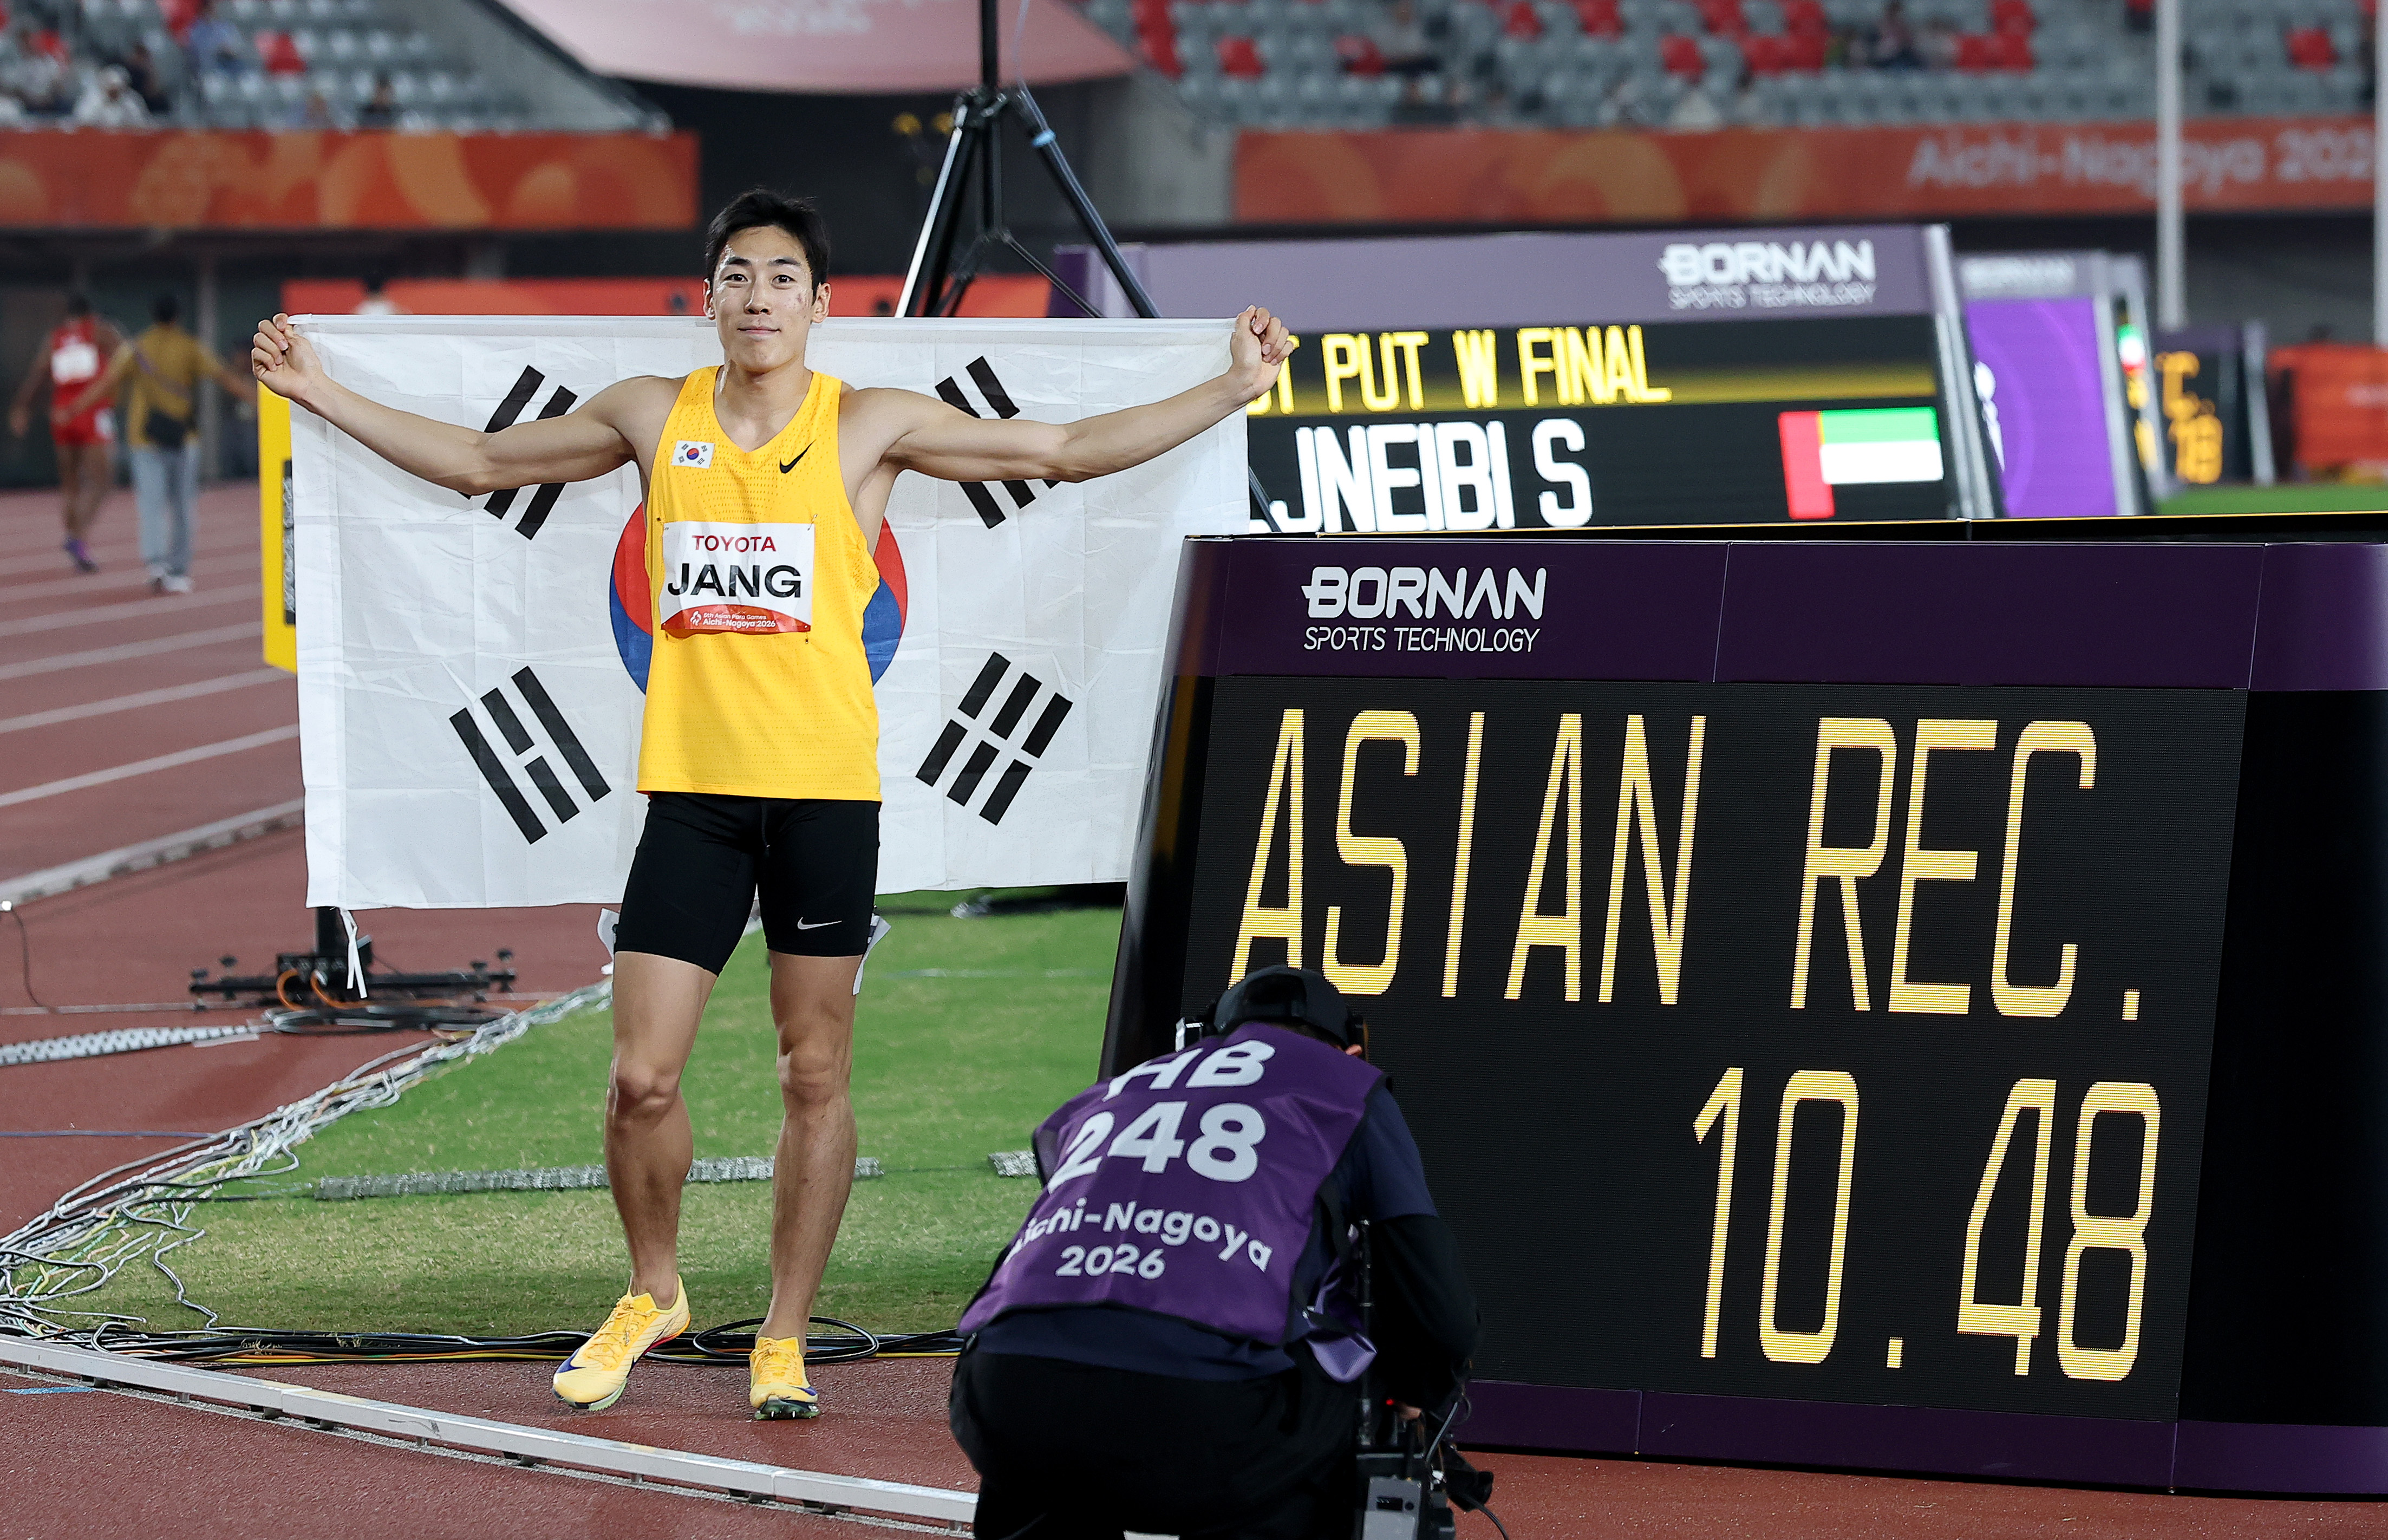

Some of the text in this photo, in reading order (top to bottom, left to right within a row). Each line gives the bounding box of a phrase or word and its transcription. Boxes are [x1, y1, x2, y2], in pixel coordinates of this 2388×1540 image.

[2278, 128, 2375, 183] 202
[1657, 239, 1877, 285] BORNAN
[1321, 331, 1429, 413] PUT
[1452, 328, 1498, 409] W
[1517, 324, 1673, 407] FINAL
[1249, 418, 1594, 533] JNEIBI S
[692, 535, 777, 552] TOYOTA
[668, 563, 801, 598] JANG
[1301, 566, 1547, 619] BORNAN
[702, 617, 756, 629] Aichi-Nagoya
[1303, 627, 1541, 652] SPORTS TECHNOLOGY
[1228, 709, 2141, 1021] ASIAN REC.
[1102, 1040, 1276, 1102] HB
[1048, 1101, 1266, 1193] 248
[1692, 1067, 2161, 1381] 10.48
[1055, 1243, 1165, 1280] 2026
